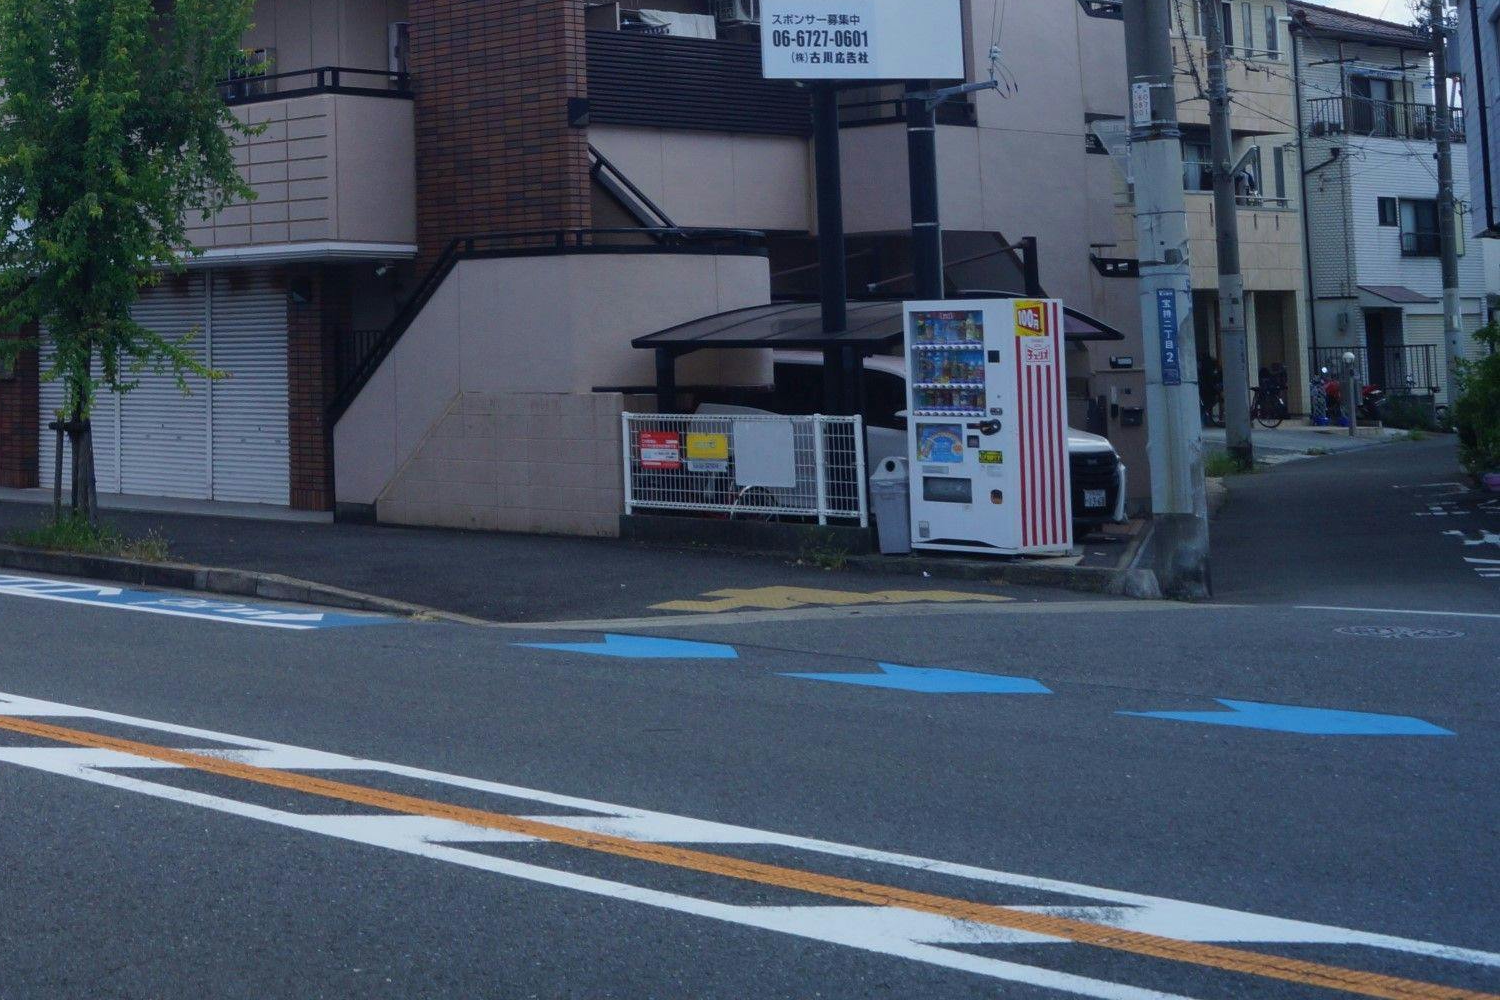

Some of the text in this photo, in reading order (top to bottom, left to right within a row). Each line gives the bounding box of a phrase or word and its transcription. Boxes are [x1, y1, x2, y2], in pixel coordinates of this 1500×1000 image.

[772, 14, 860, 26] スポンサー募集中
[772, 29, 869, 48] 06-6727-0601
